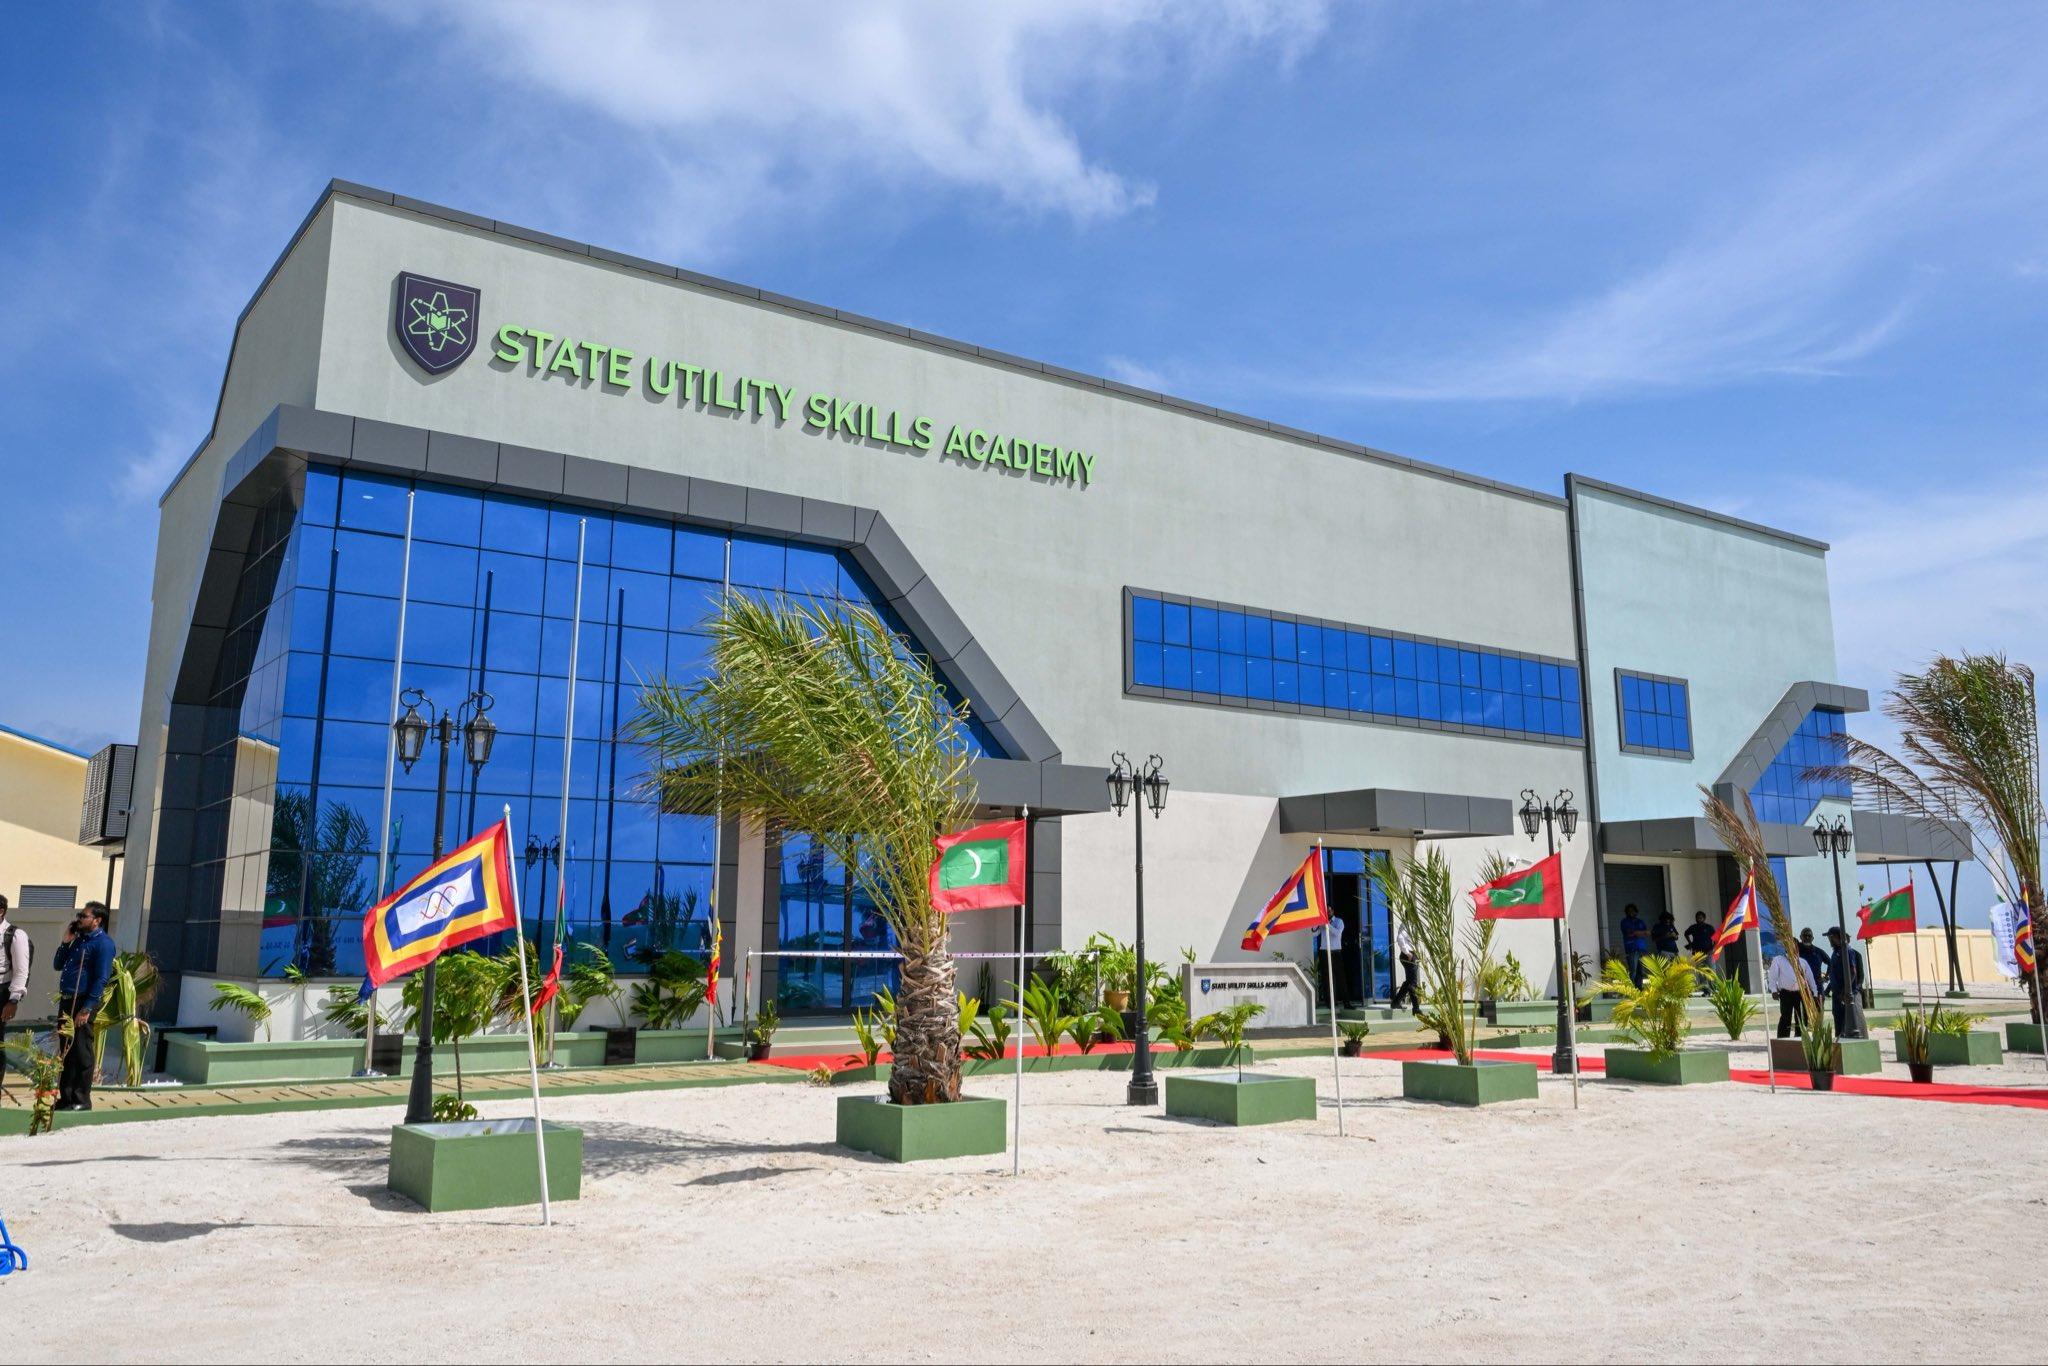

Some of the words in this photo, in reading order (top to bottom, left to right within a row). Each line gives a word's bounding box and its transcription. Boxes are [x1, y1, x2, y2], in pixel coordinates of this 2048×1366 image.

[496, 324, 634, 387] STATE
[649, 358, 797, 421] UTILITY
[806, 393, 935, 450] SKILLS
[945, 425, 1097, 485] ACADEMY
